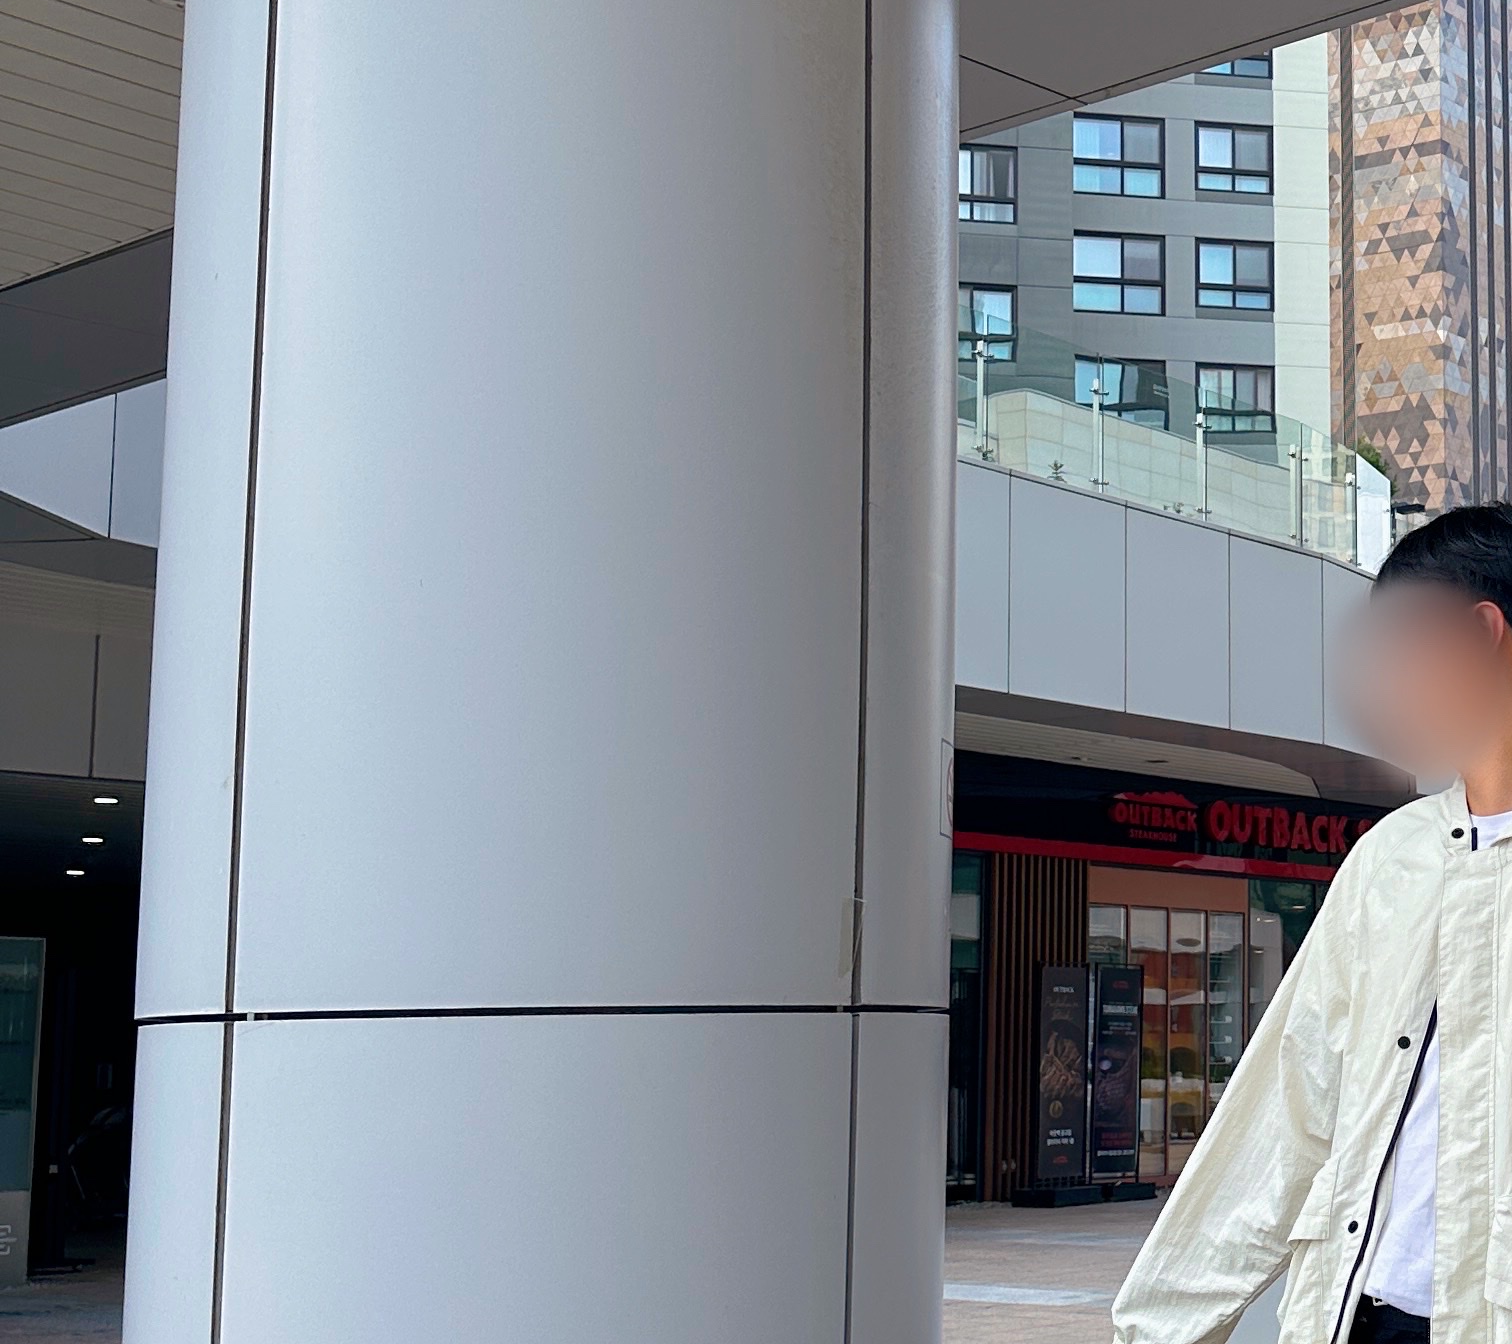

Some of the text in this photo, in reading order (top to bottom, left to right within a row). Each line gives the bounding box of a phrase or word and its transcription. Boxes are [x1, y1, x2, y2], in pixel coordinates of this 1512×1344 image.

[1112, 801, 1198, 833] OUTBACK
[1208, 799, 1350, 854] OUTBACK
[1128, 828, 1178, 843] STEAKHOUSE
